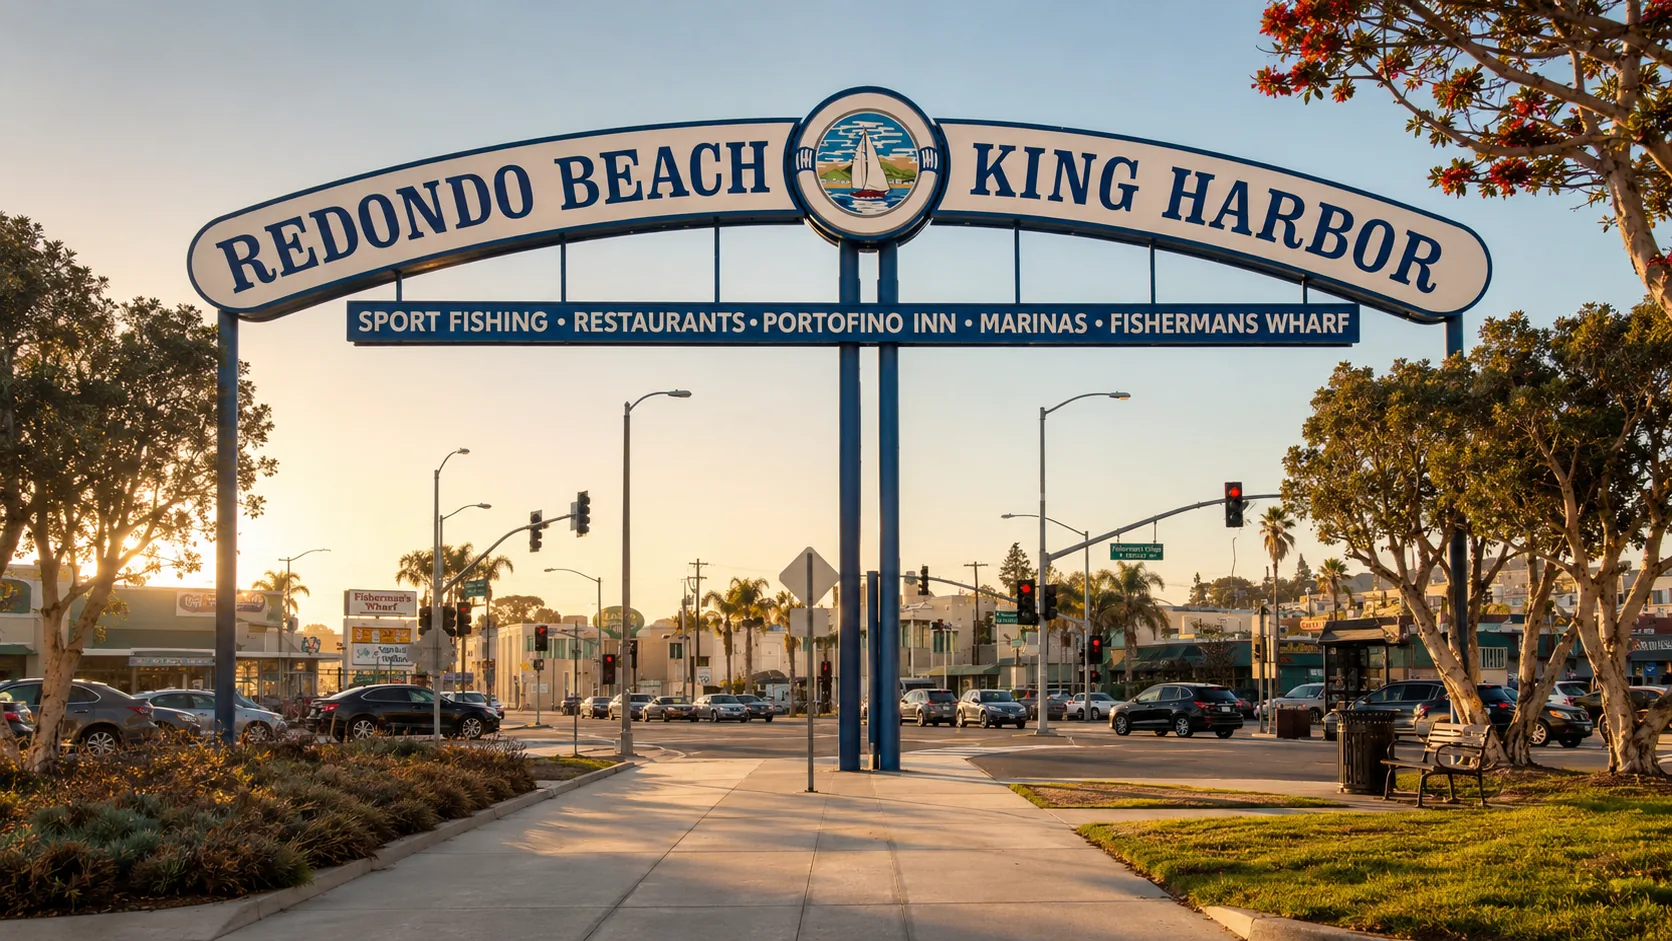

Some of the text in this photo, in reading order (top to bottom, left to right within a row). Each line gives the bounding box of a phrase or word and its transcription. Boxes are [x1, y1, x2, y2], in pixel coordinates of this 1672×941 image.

[216, 140, 771, 292] REDONDO BEACH
[970, 143, 1441, 292] KING HARBOR
[358, 311, 1350, 334] SPORT FISHING RESTAURANTS PORTOFINO INN MARINAS FISHERMANS WHARF
[365, 602, 398, 611] Wharf
